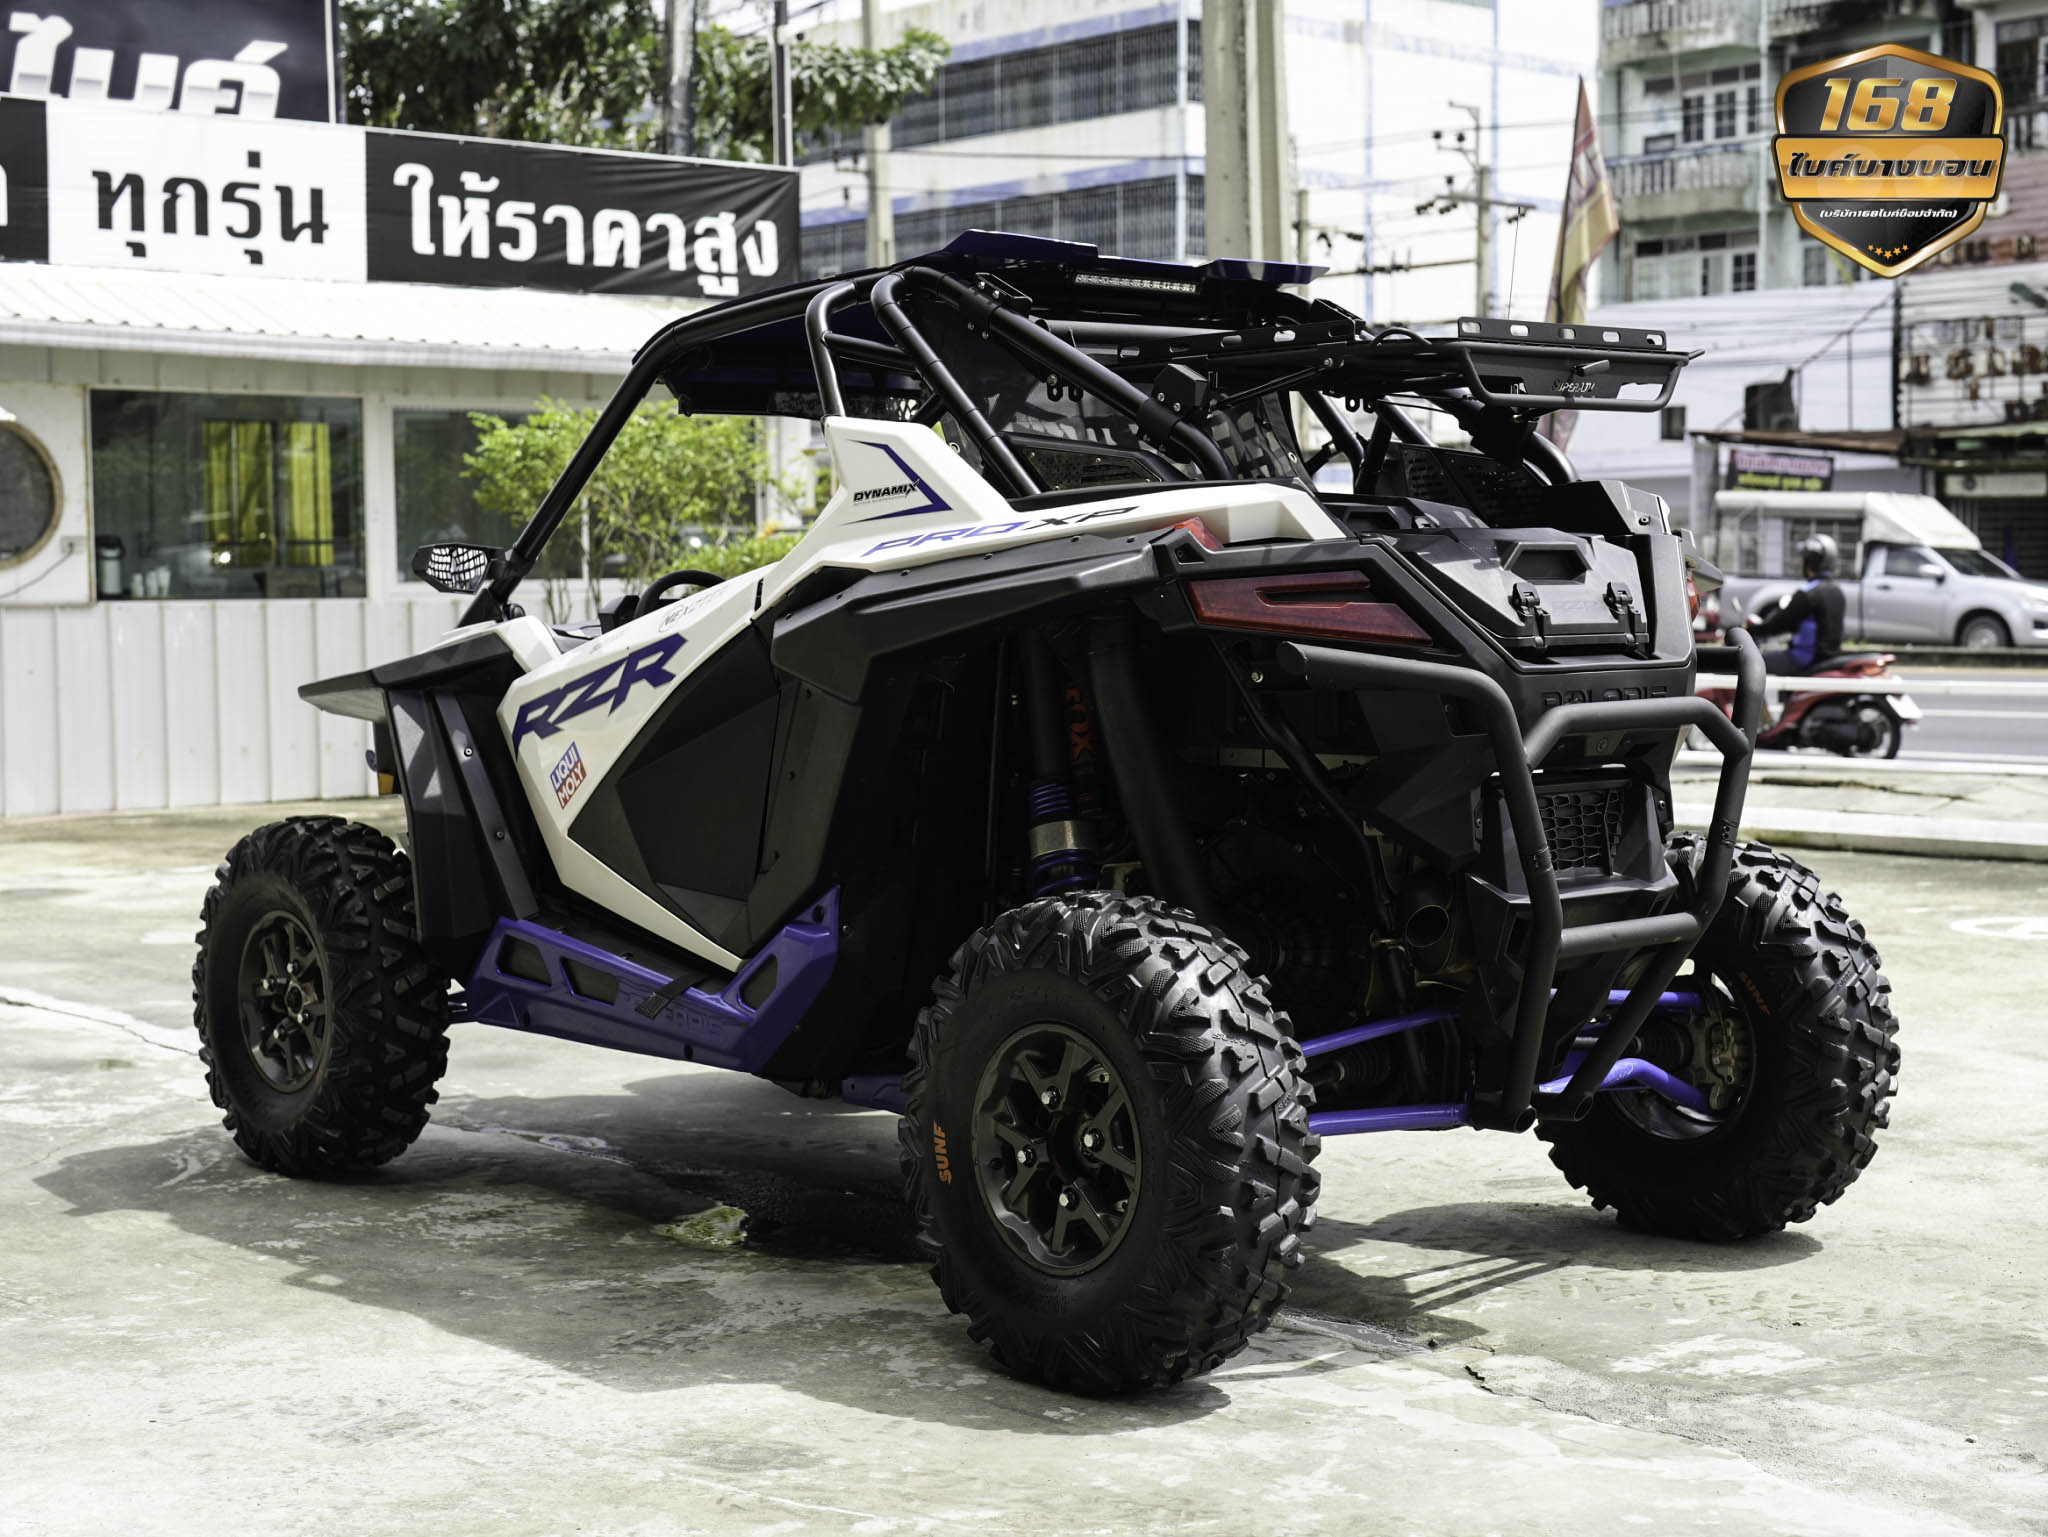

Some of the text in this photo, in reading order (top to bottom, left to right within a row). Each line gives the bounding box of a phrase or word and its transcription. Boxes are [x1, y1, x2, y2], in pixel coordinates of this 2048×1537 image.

[91, 150, 330, 265] ทุกรุ่น
[393, 161, 780, 297] ให้ราคาสูง
[853, 479, 920, 502] DYNAMIX
[511, 632, 688, 756] RZR
[1065, 687, 1096, 761] FOX
[550, 743, 580, 790] LIQUI
[557, 760, 585, 809] MOLY
[933, 1119, 952, 1184] SUNF
